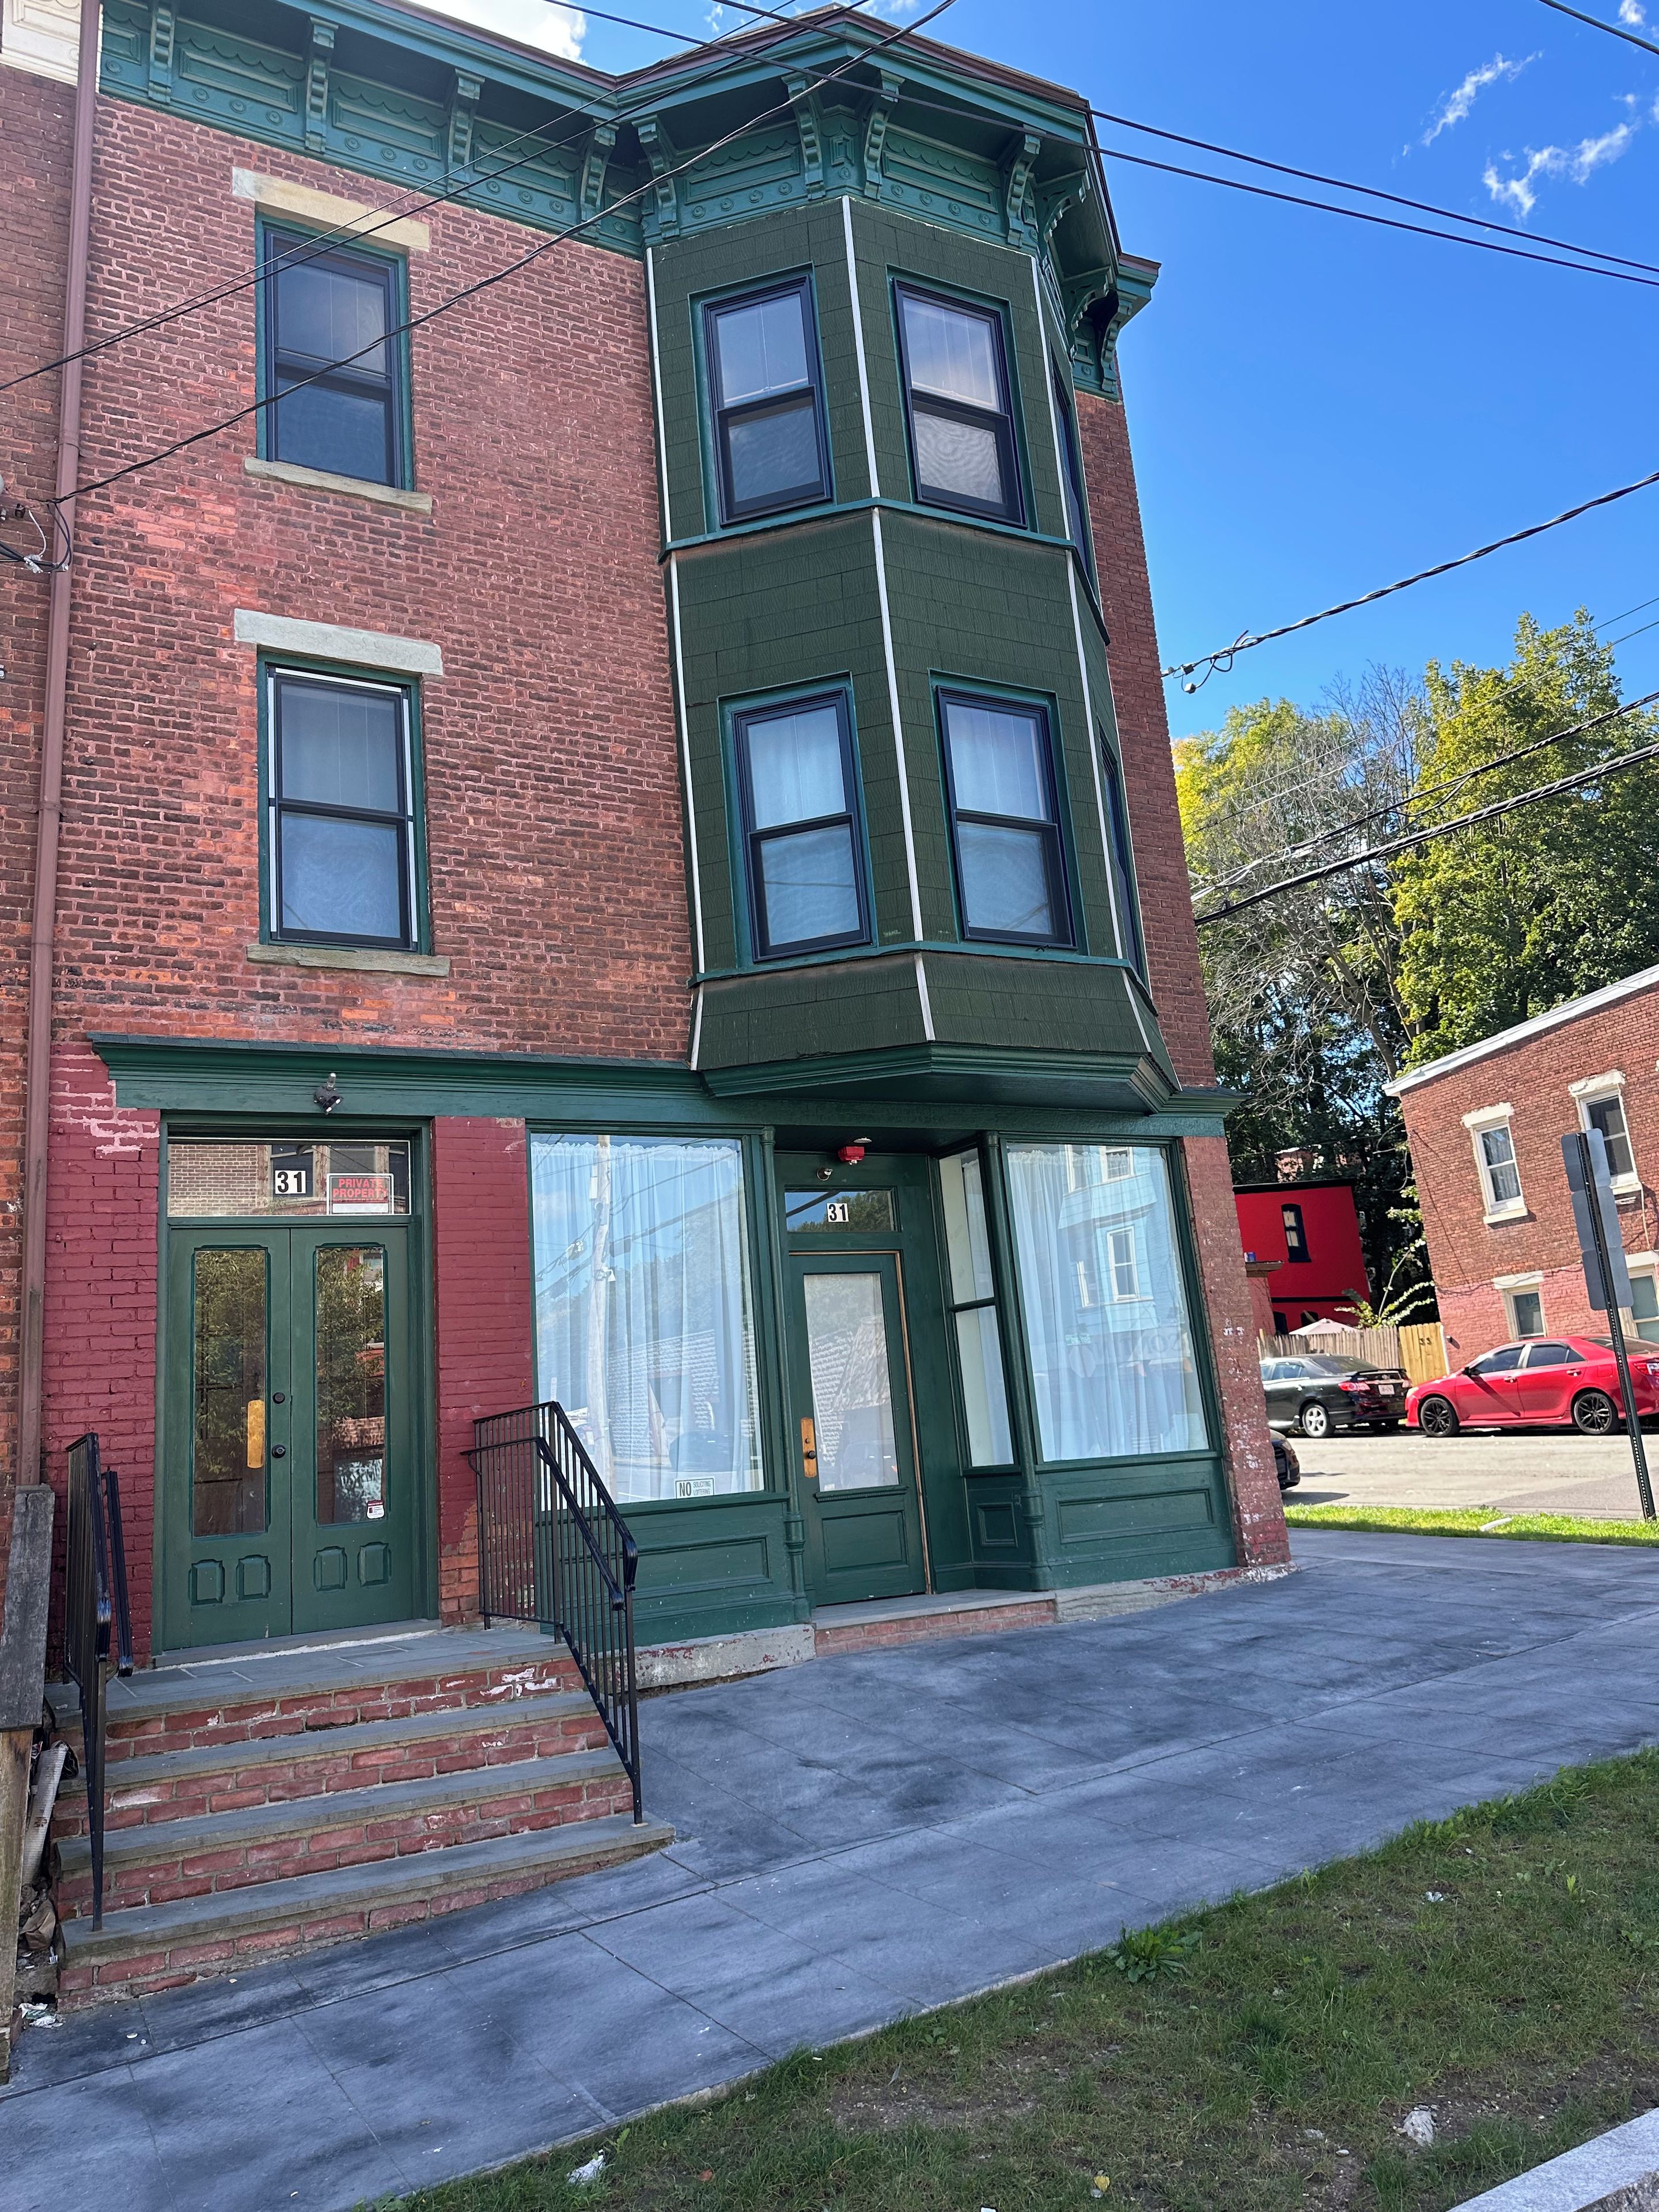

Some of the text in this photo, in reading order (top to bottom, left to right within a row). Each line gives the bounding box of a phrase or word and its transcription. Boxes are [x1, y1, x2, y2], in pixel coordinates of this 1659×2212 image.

[278, 1171, 302, 1192] 31
[339, 1179, 383, 1188] PRIVATE
[333, 1188, 387, 1198] PROPERTY
[829, 1204, 846, 1221] 31
[680, 1482, 691, 1497] NO
